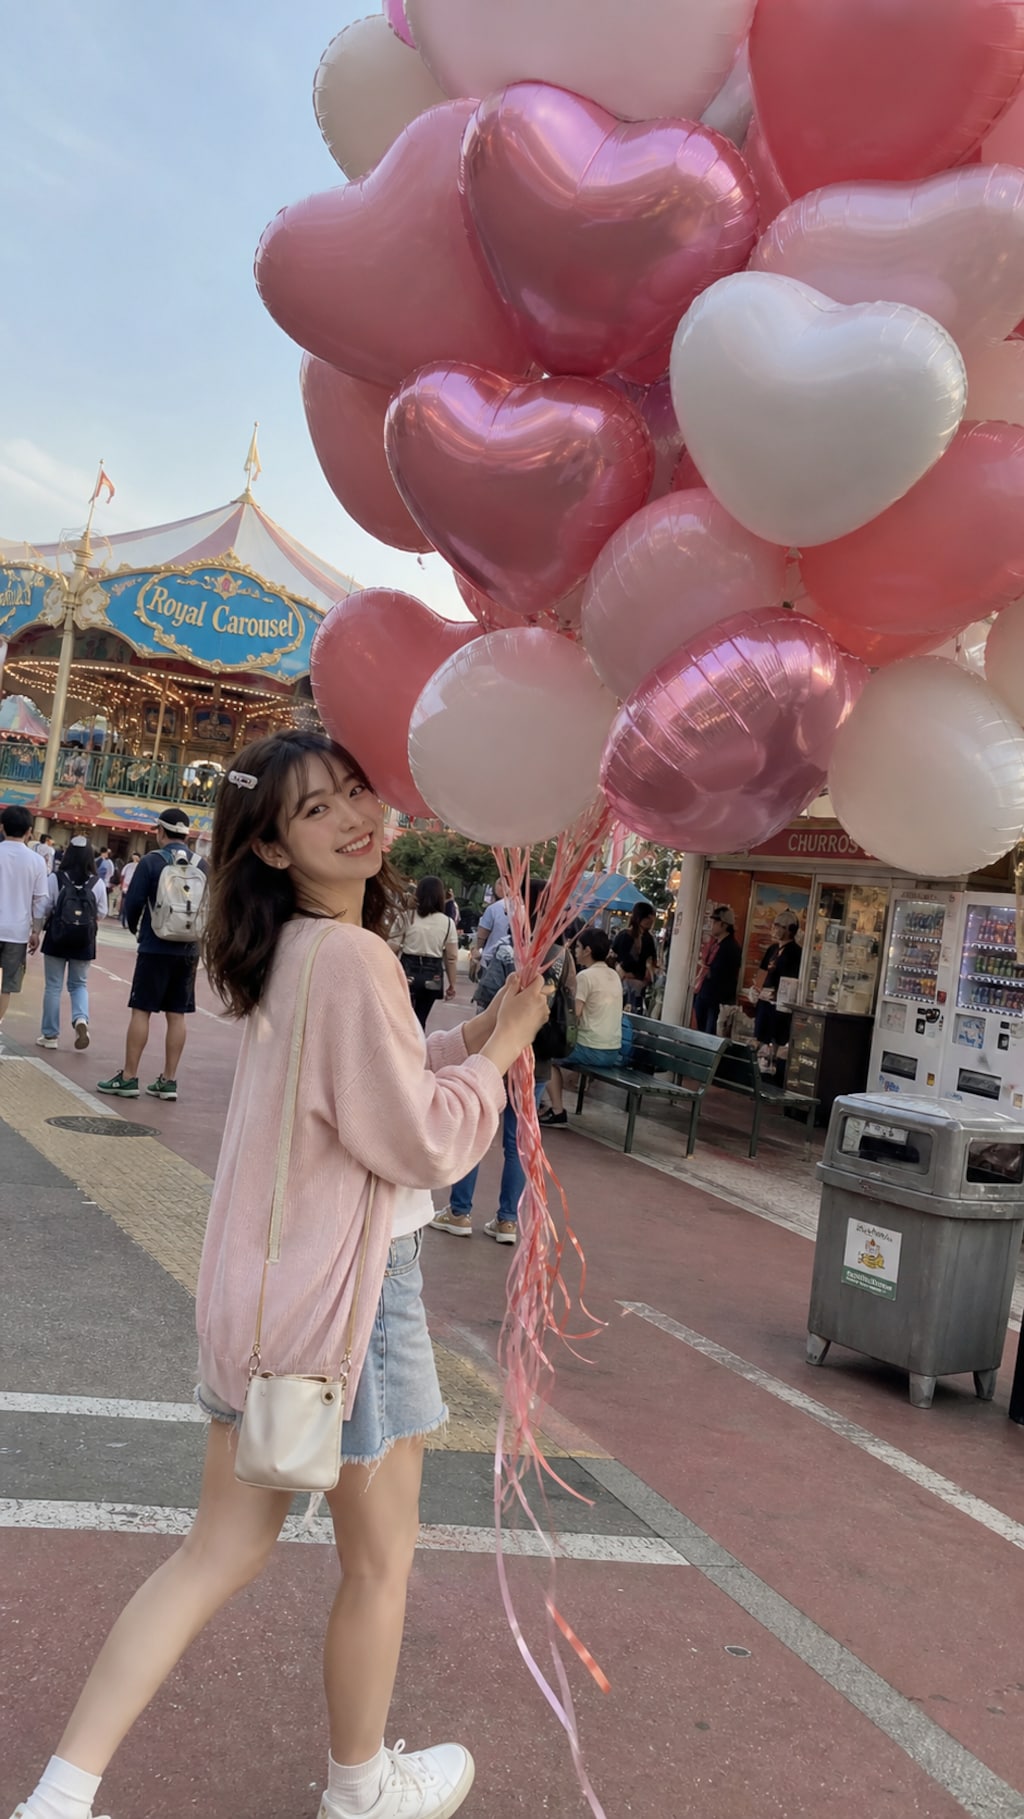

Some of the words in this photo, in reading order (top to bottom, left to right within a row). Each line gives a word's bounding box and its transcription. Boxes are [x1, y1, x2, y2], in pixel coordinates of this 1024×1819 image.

[146, 586, 208, 627] Royal
[212, 604, 294, 639] Carousel
[788, 833, 859, 854] CHURROS
